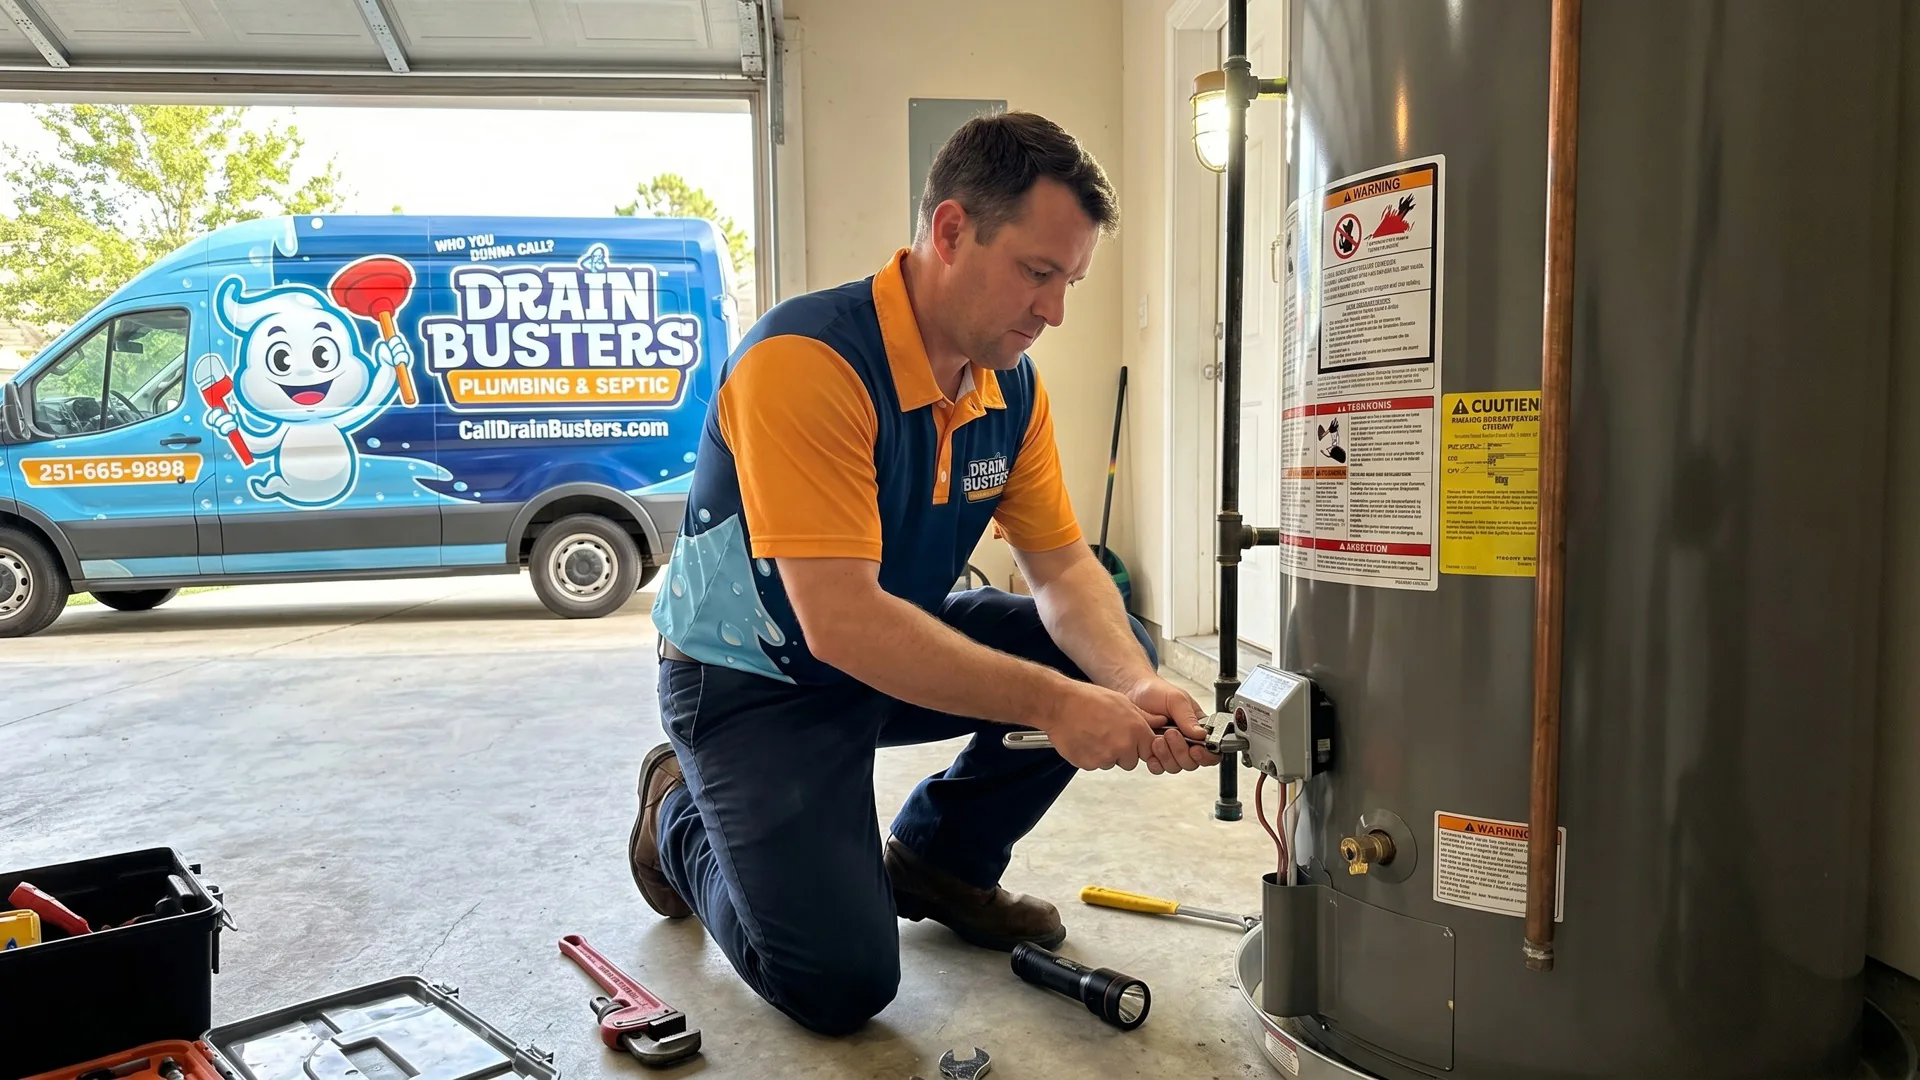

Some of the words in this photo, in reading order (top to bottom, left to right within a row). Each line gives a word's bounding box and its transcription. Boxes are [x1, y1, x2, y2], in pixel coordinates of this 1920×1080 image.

[1353, 178, 1400, 199] WARNING
[435, 237, 466, 252] WHO
[467, 234, 494, 248] YOU
[517, 239, 554, 256] CALL?
[459, 271, 649, 320] DRAIN
[427, 322, 694, 368] BUSTERS
[459, 377, 570, 395] PLUMBING
[576, 377, 590, 394] &
[596, 376, 669, 394] SEPTIC
[1471, 397, 1541, 413] CUUTIEN
[459, 419, 669, 440] CallDrainBusters.com
[39, 460, 184, 482] 251-665-9898
[970, 458, 1006, 477] DRAIN
[963, 470, 1008, 491] BUSTERS
